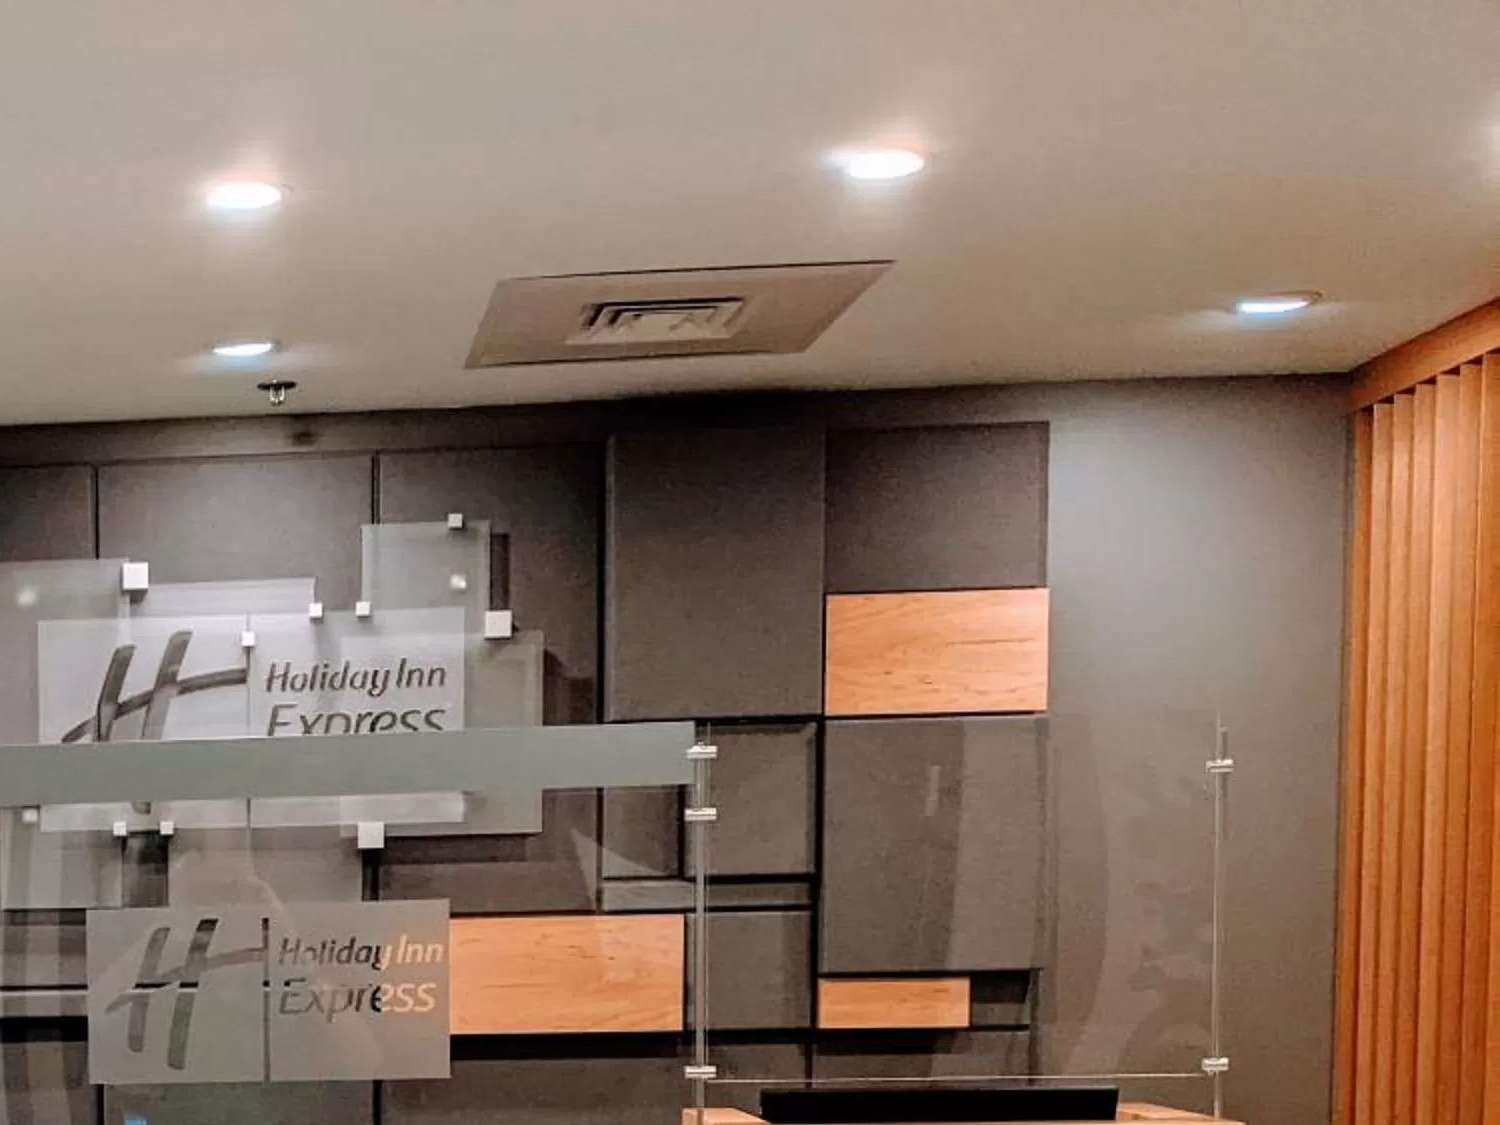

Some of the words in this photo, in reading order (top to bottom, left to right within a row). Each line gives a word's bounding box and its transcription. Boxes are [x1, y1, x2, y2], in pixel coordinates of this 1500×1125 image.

[266, 659, 391, 698] Holiday
[395, 657, 447, 688] Inn
[279, 935, 394, 972] Holiday
[395, 934, 444, 964] Inn
[278, 977, 438, 1024] Express
